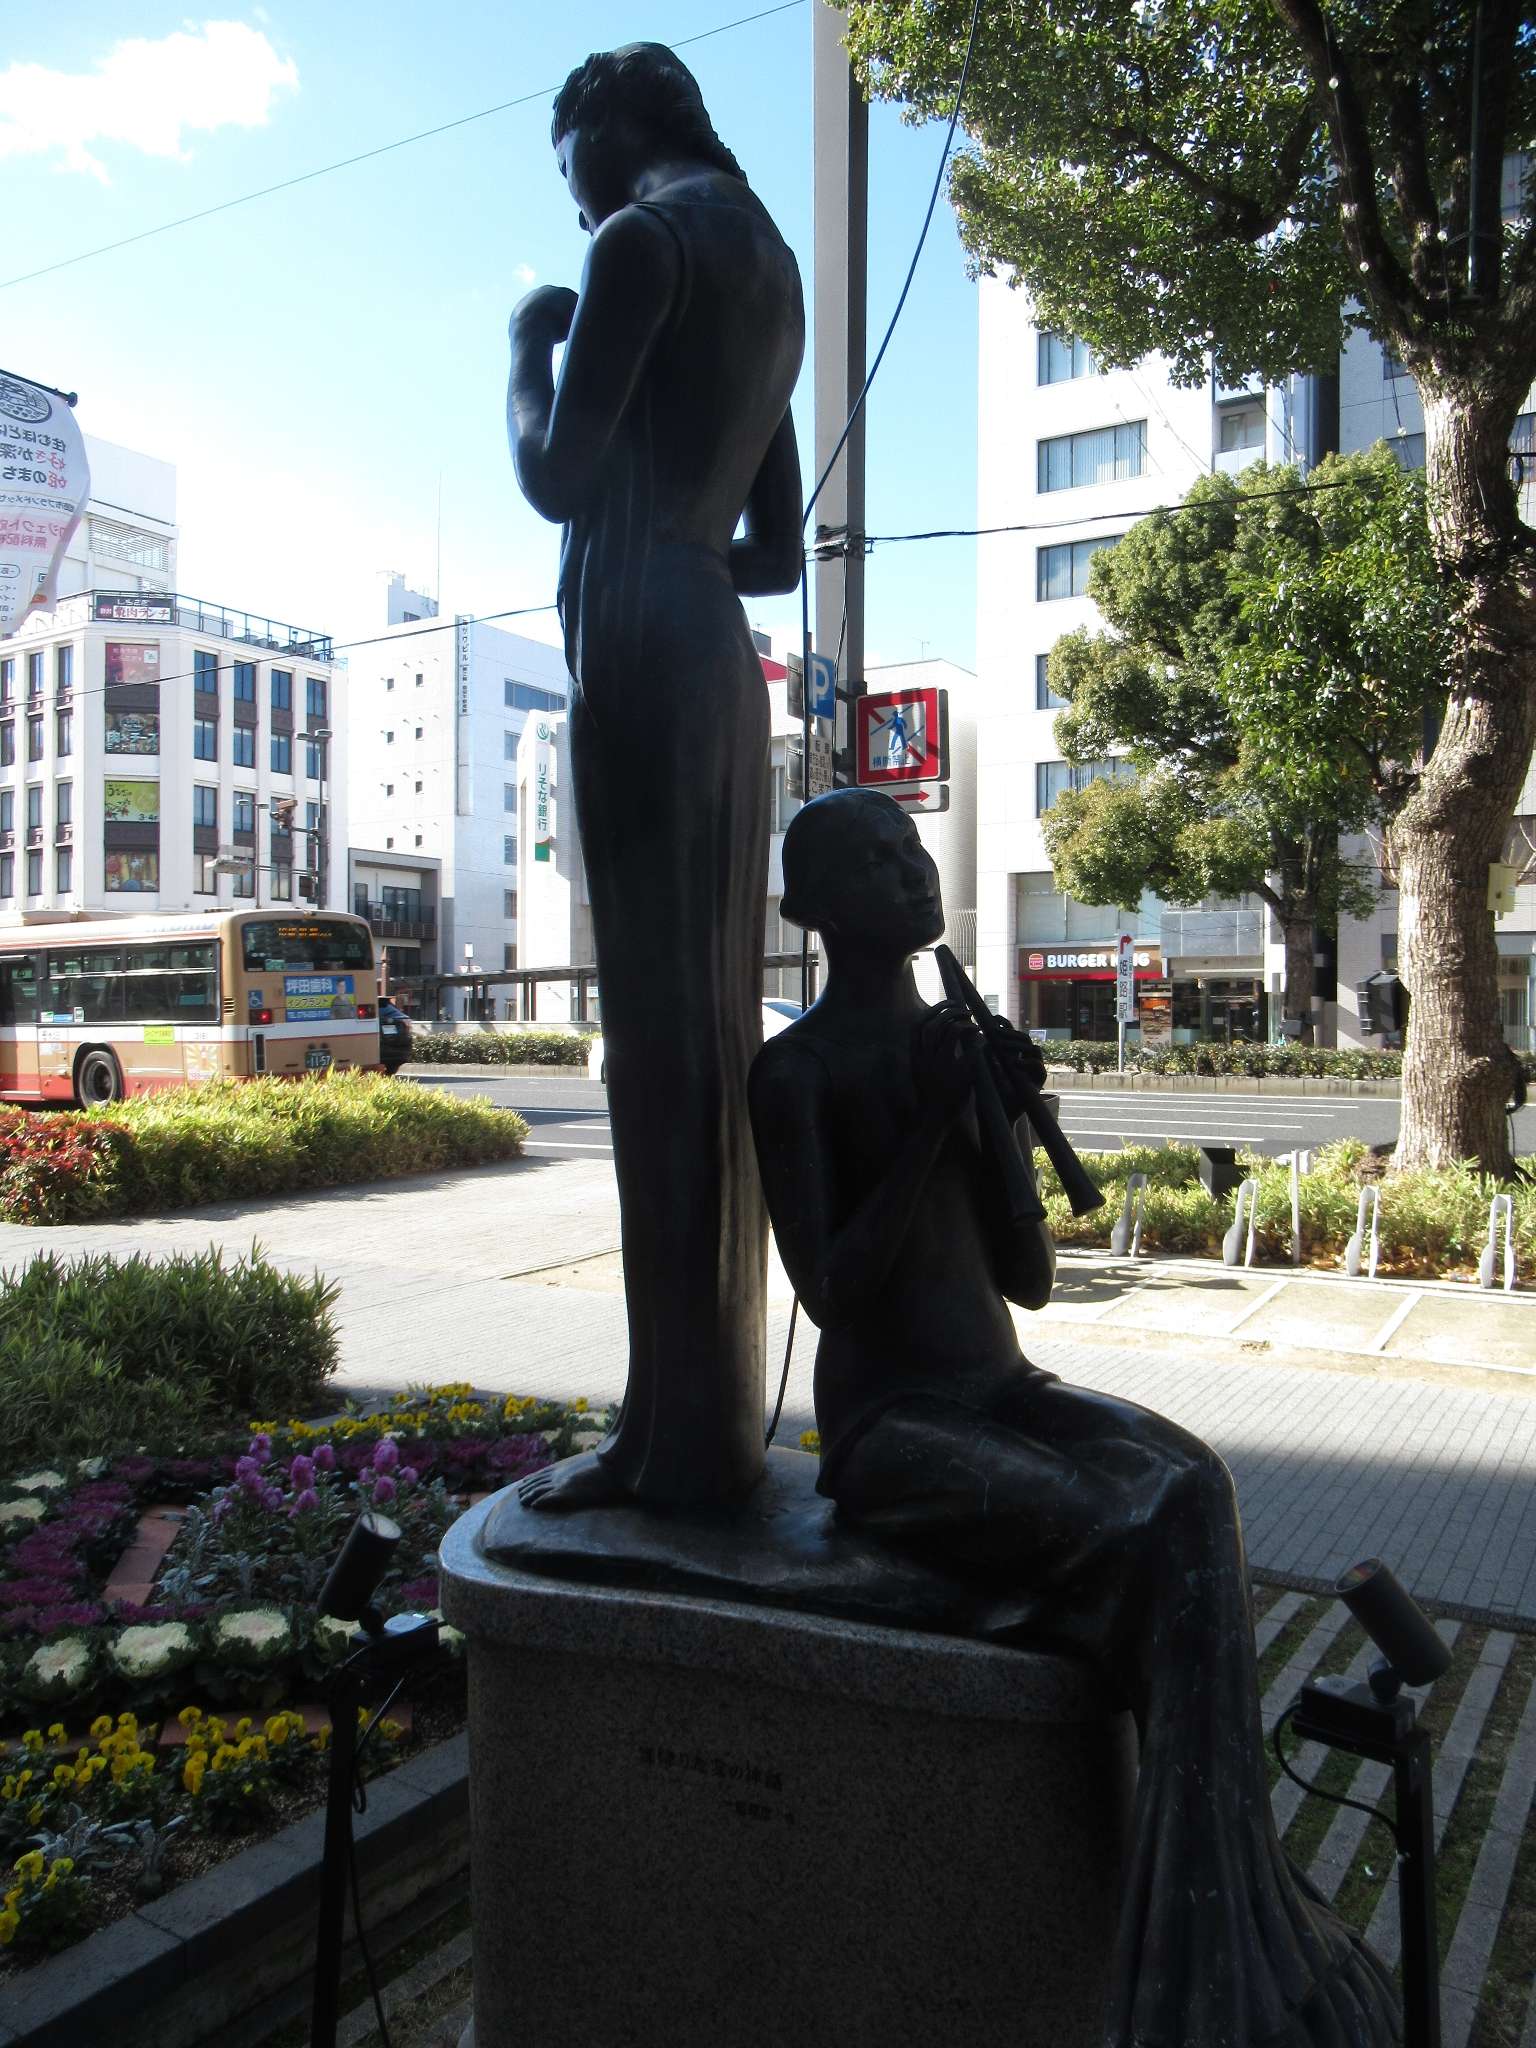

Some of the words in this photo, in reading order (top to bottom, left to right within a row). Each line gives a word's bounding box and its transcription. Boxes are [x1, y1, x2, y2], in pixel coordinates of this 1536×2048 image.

[115, 606, 168, 618] 焼肉ランチ
[812, 661, 829, 709] P
[537, 763, 547, 831] りそな銀行
[1047, 953, 1107, 968] BURGER
[1119, 959, 1128, 1018] 姫路駅
